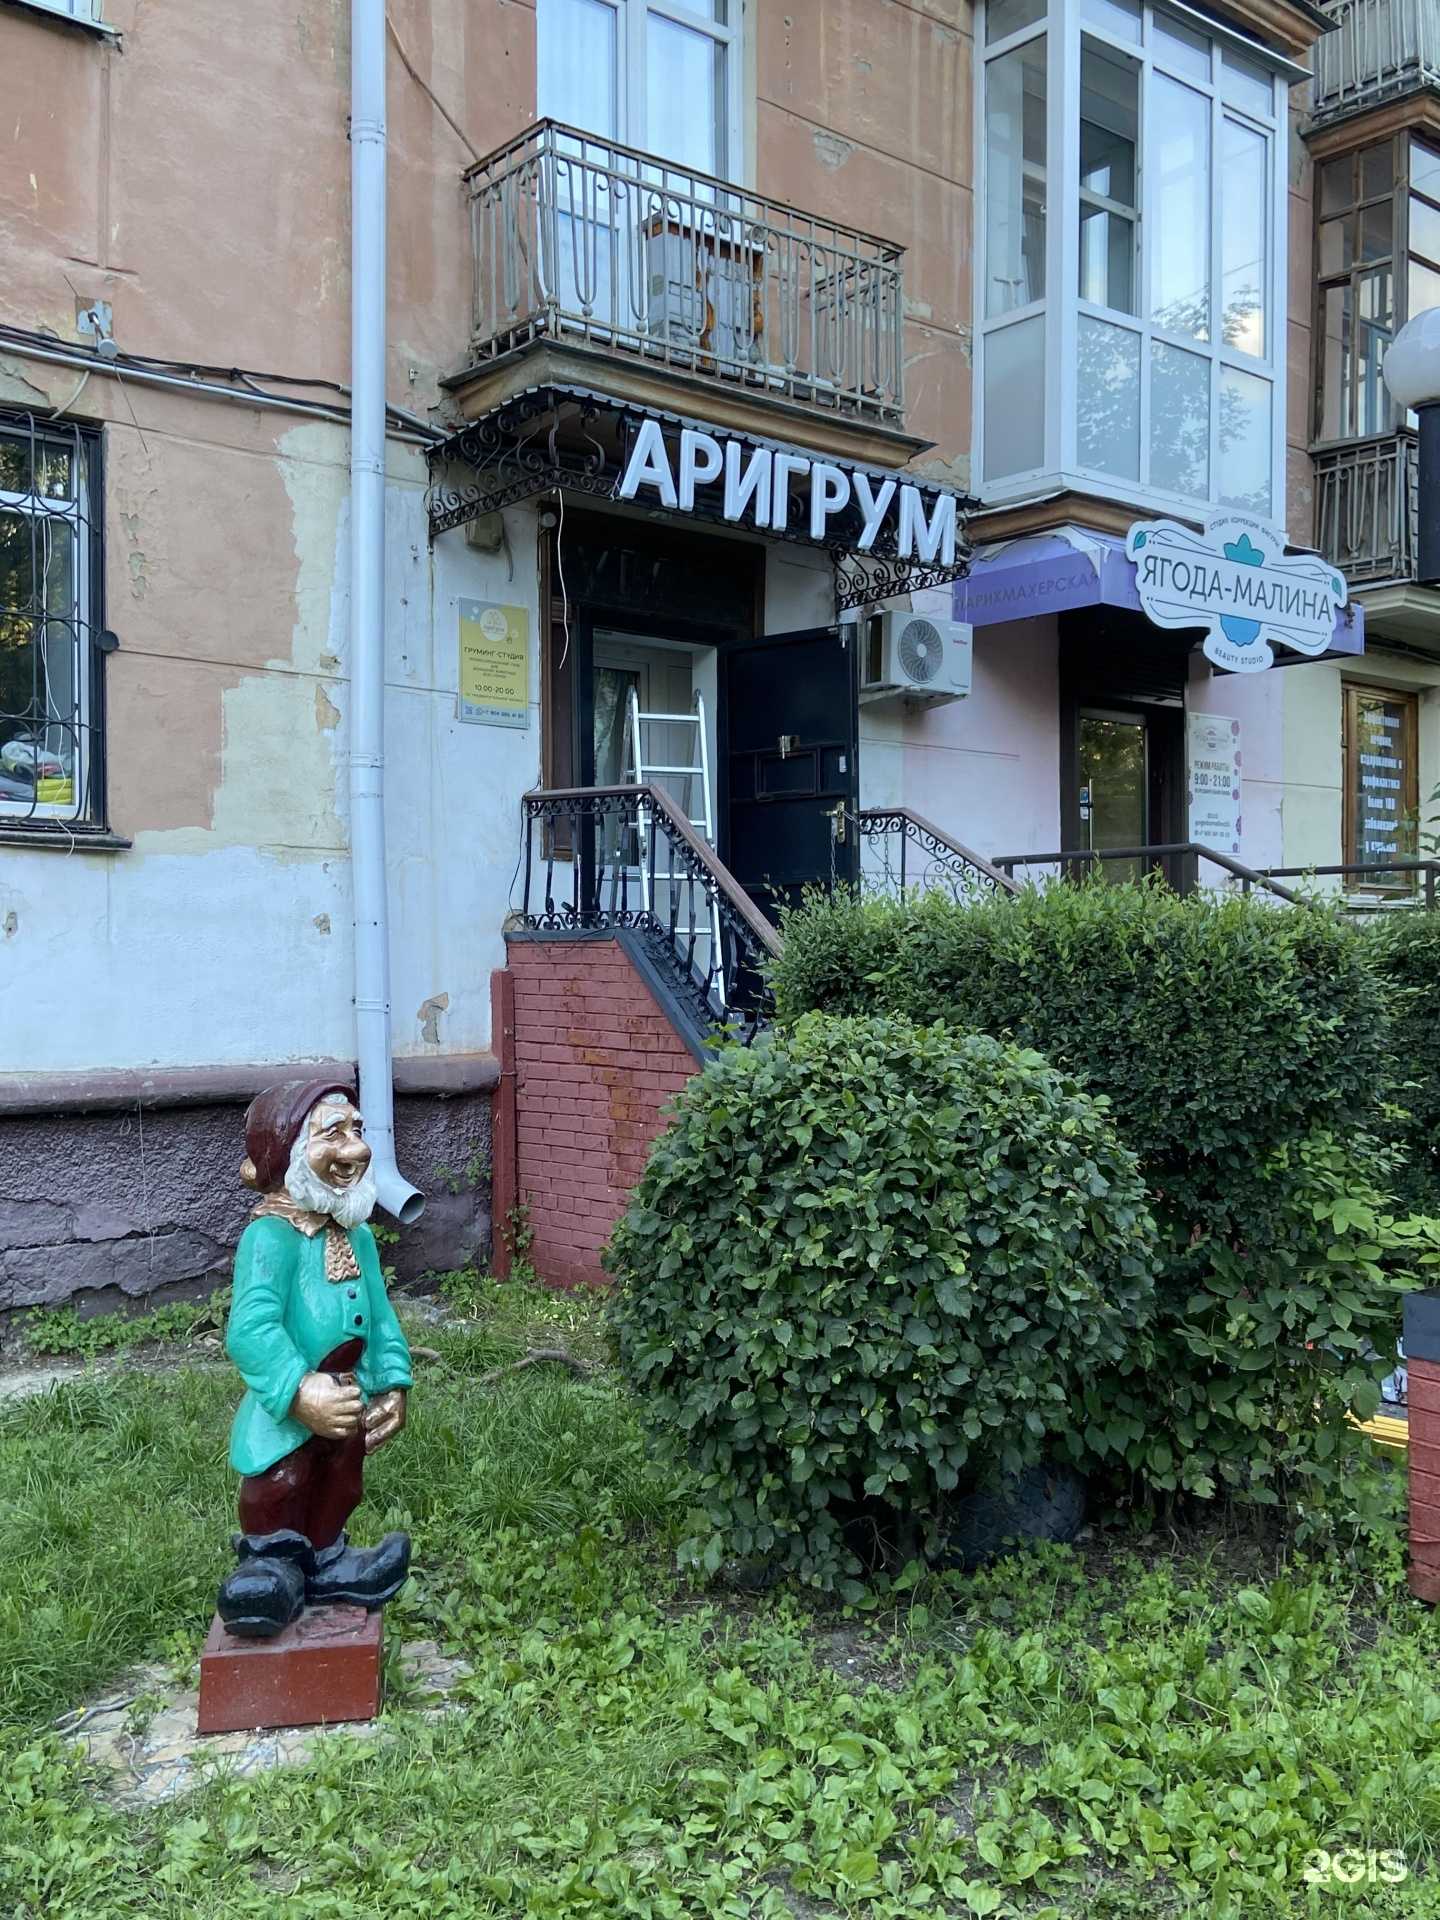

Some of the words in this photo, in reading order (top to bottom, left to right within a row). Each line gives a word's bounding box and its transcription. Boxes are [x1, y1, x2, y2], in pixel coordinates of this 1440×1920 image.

[620, 419, 956, 567] АРИГРУМ
[1210, 517, 1229, 531] СТУДИЯ
[1142, 555, 1332, 622] ЯГОДА-МАЛИНА
[1215, 648, 1238, 663] BEAUTY
[1241, 656, 1264, 664] STUDIO
[1194, 773, 1208, 785] 9:00
[1213, 775, 1231, 787] 21:00
